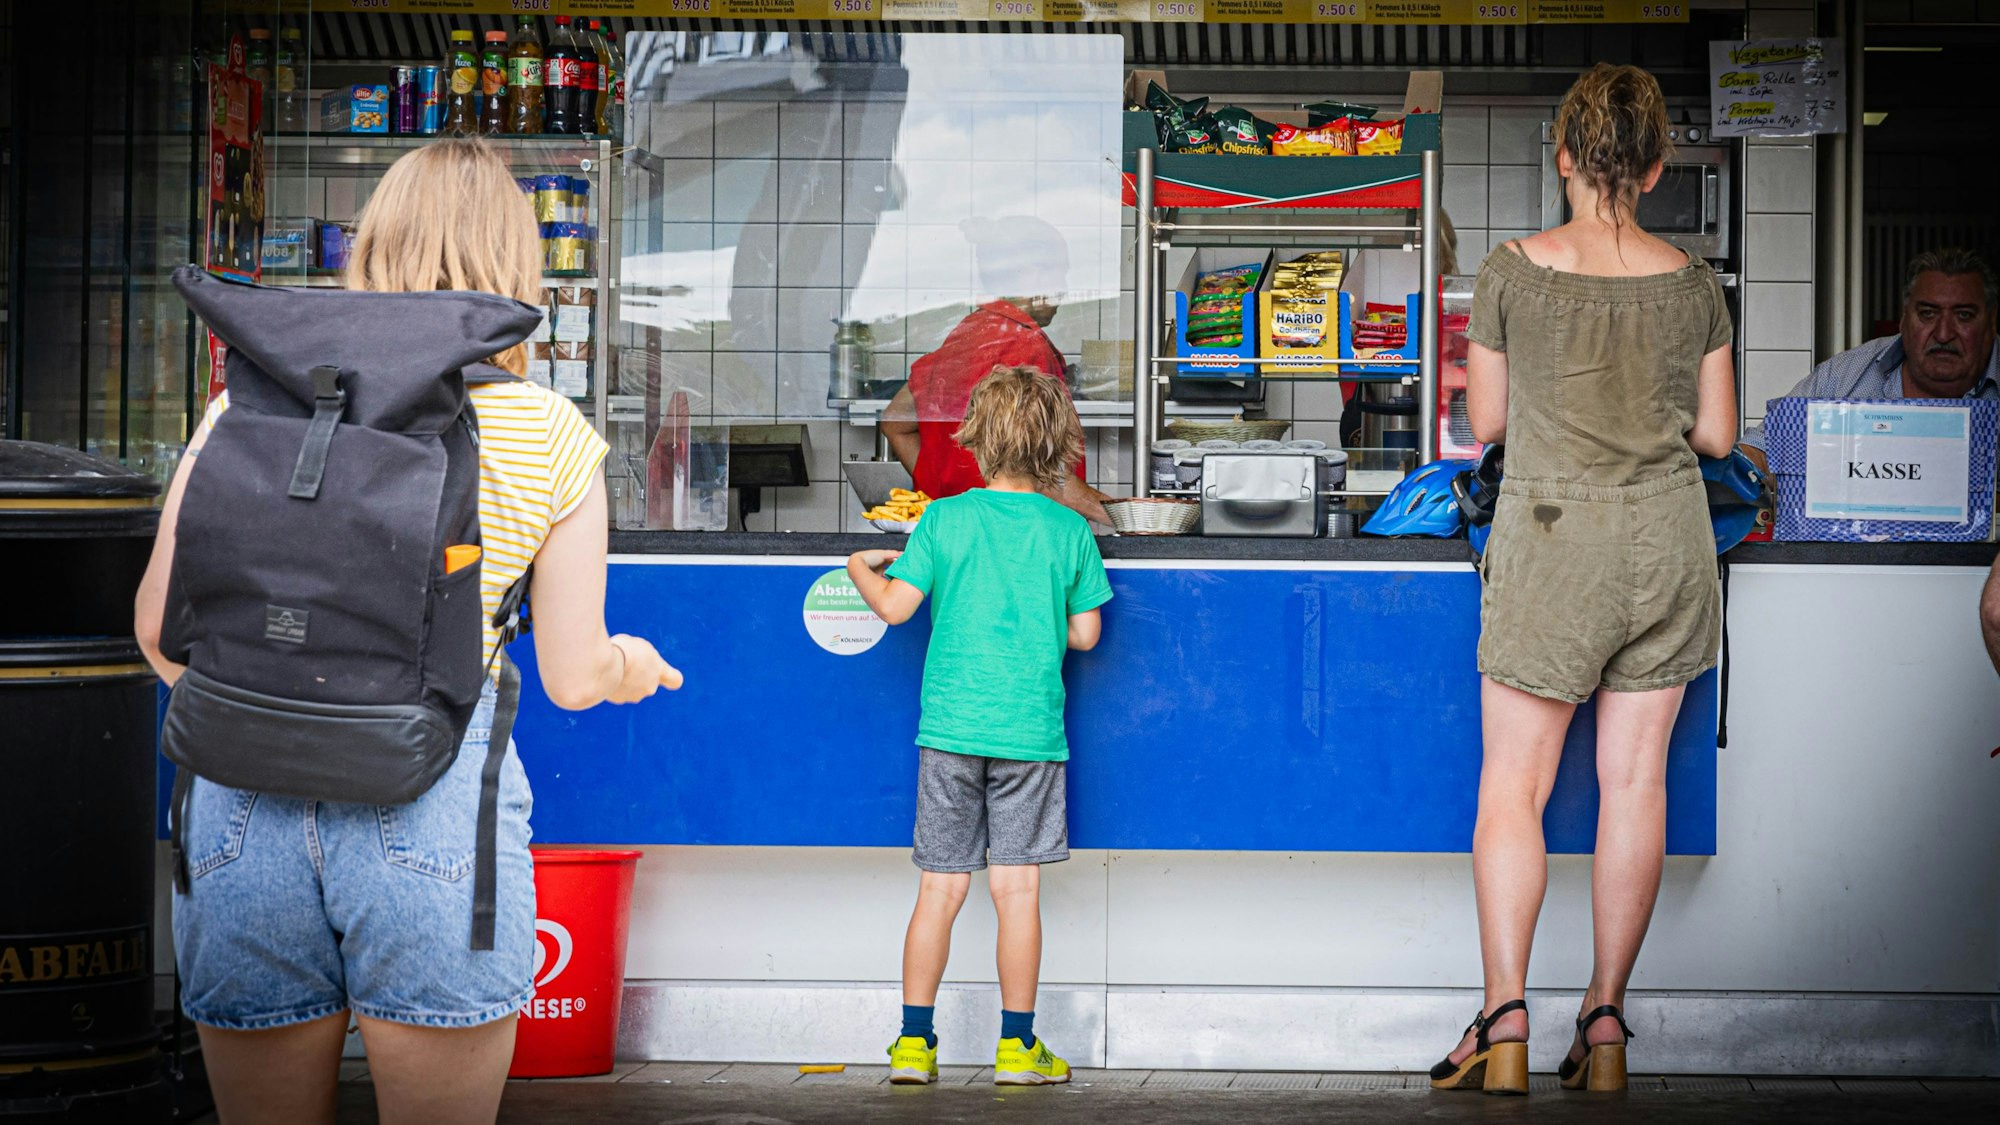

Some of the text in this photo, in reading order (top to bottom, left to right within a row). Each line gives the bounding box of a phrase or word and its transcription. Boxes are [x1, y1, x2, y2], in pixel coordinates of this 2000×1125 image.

[672, 0, 710, 10] 9.90 €
[834, 0, 872, 11] 9.50 €
[996, 3, 1033, 14] 9.90 €
[1157, 4, 1195, 14] 9.50 €
[1318, 4, 1356, 15] 9.50 €
[1480, 6, 1516, 16] 9.50 €
[1643, 6, 1680, 17] 9.50 €
[1729, 102, 1772, 115] Pommes
[1847, 461, 1922, 480] KASSE
[0, 936, 146, 982] ABFALL
